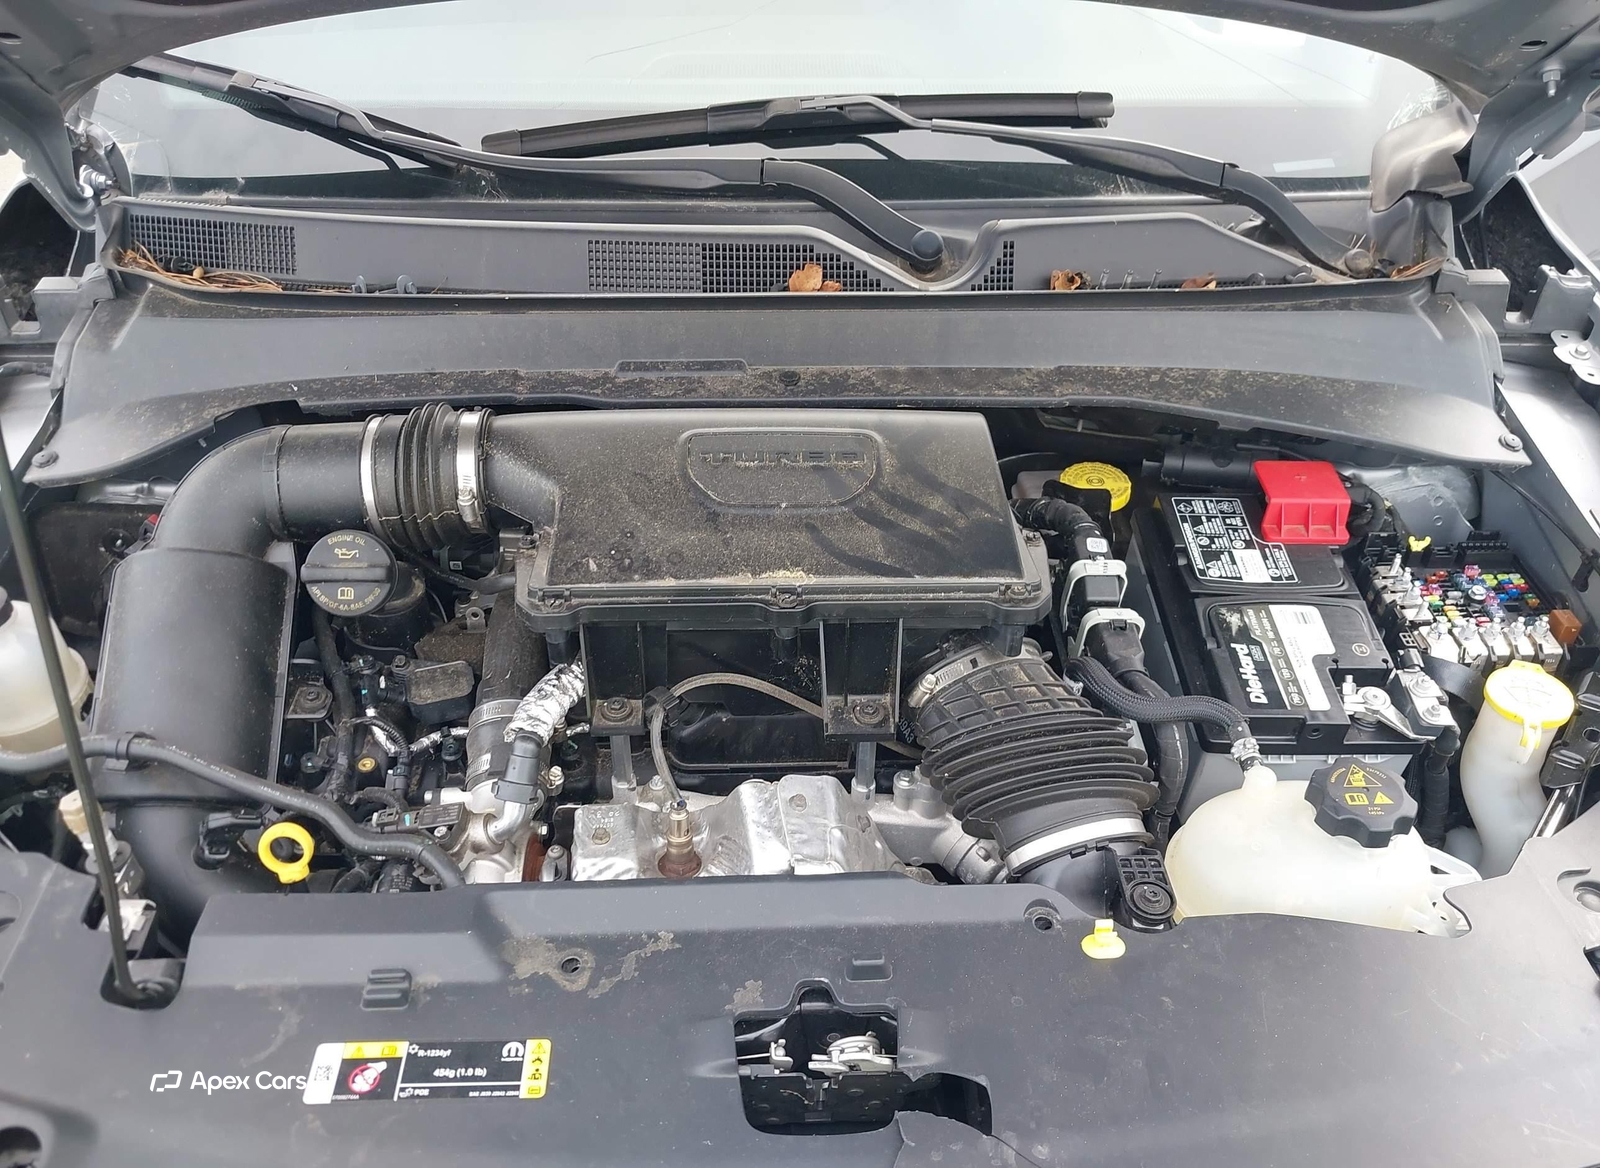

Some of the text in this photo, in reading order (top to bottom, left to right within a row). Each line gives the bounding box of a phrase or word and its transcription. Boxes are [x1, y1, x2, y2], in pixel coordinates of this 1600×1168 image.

[327, 535, 367, 546] ENGINE OIL
[311, 585, 321, 598] API
[1246, 608, 1263, 637] PLATINUM
[1230, 642, 1269, 704] DieHard
[417, 1049, 452, 1058] R-1234yf
[432, 1067, 487, 1078] 454g (1.0 lb)
